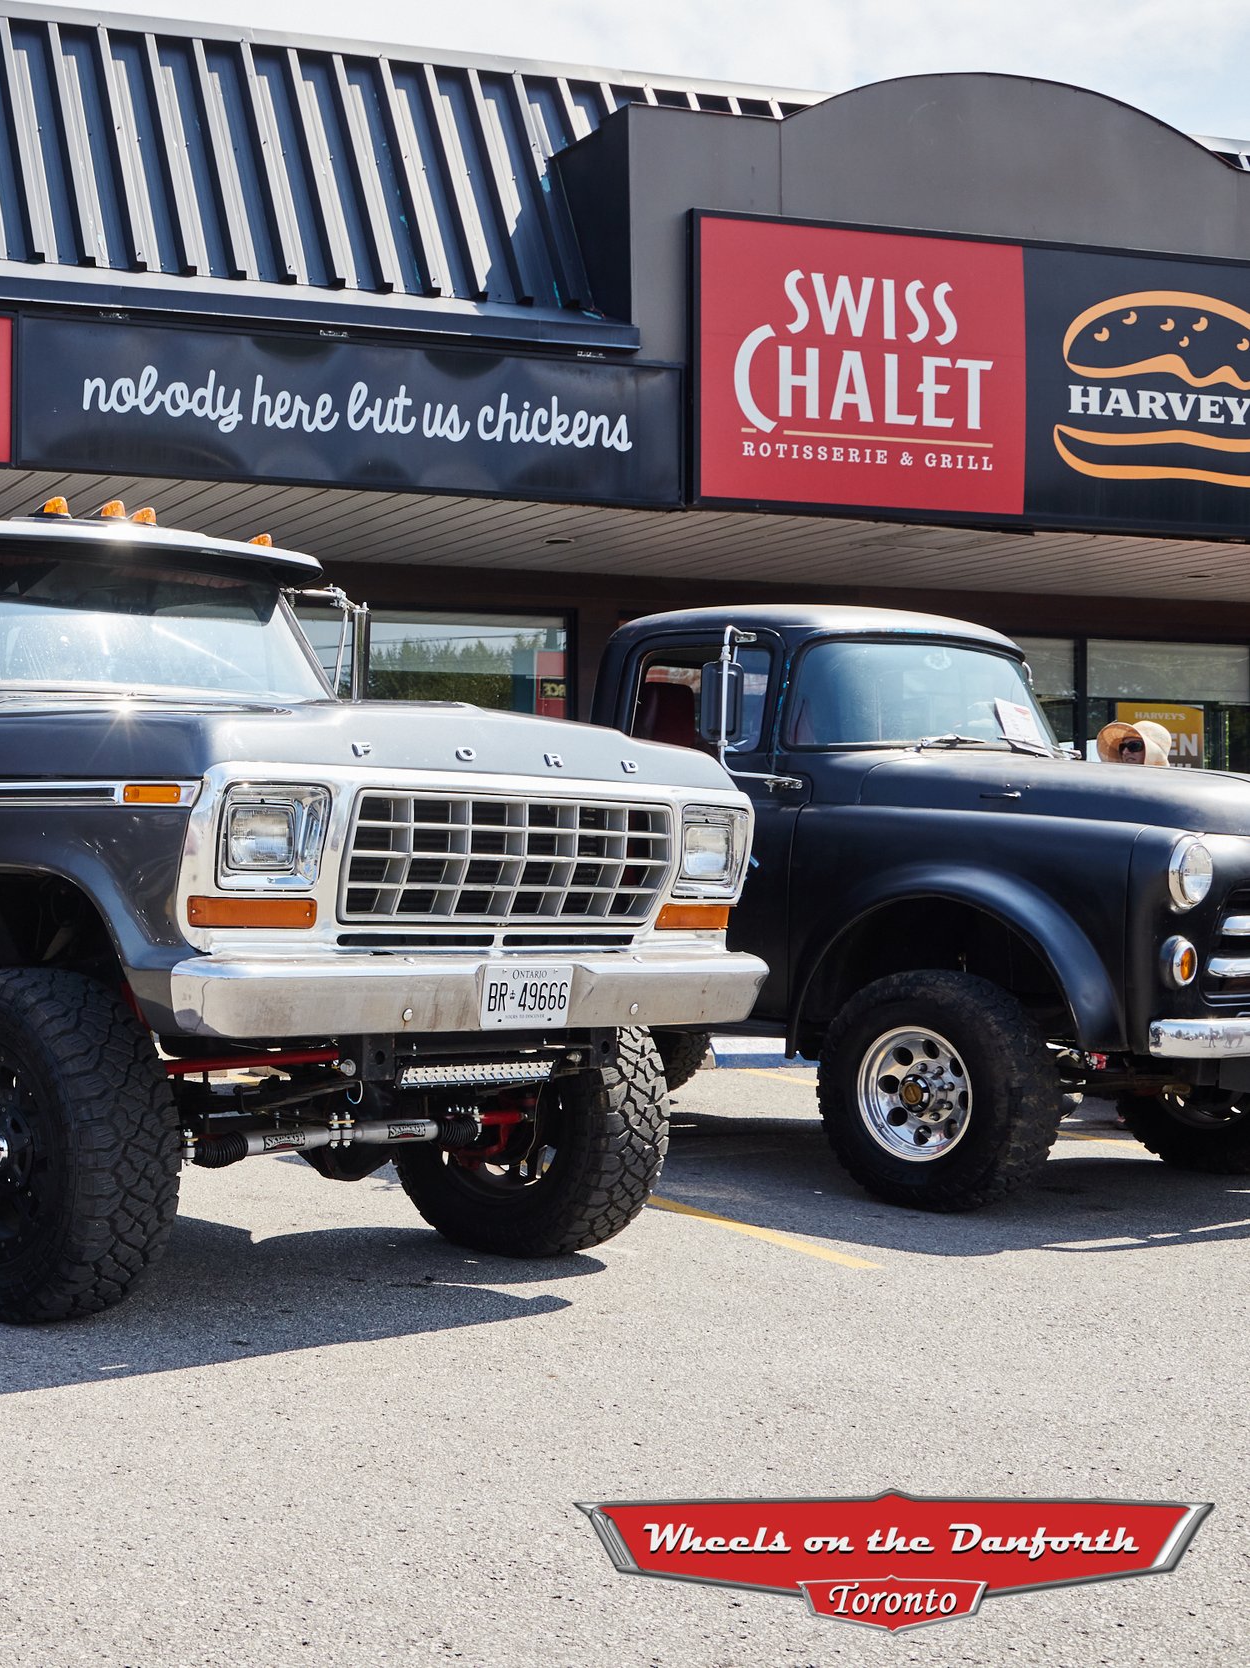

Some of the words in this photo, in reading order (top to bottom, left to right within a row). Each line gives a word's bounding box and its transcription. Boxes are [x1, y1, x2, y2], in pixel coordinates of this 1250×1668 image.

[784, 269, 958, 345] SWISS
[734, 324, 993, 433] CHALET
[82, 365, 243, 433] nobody
[251, 374, 339, 432] here
[347, 381, 416, 434] but
[423, 402, 470, 442] us
[477, 392, 632, 452] chickens
[1068, 384, 1250, 425] HARVEY
[742, 441, 887, 464] ROTISSERIE
[900, 452, 913, 466] &
[924, 453, 993, 471] GRILL
[1134, 711, 1186, 721] HARVEY'S
[352, 742, 638, 773] FORD
[1169, 733, 1198, 756] EN
[512, 969, 548, 980] ONTARIO
[487, 982, 509, 1012] BR
[518, 982, 568, 1011] 49666
